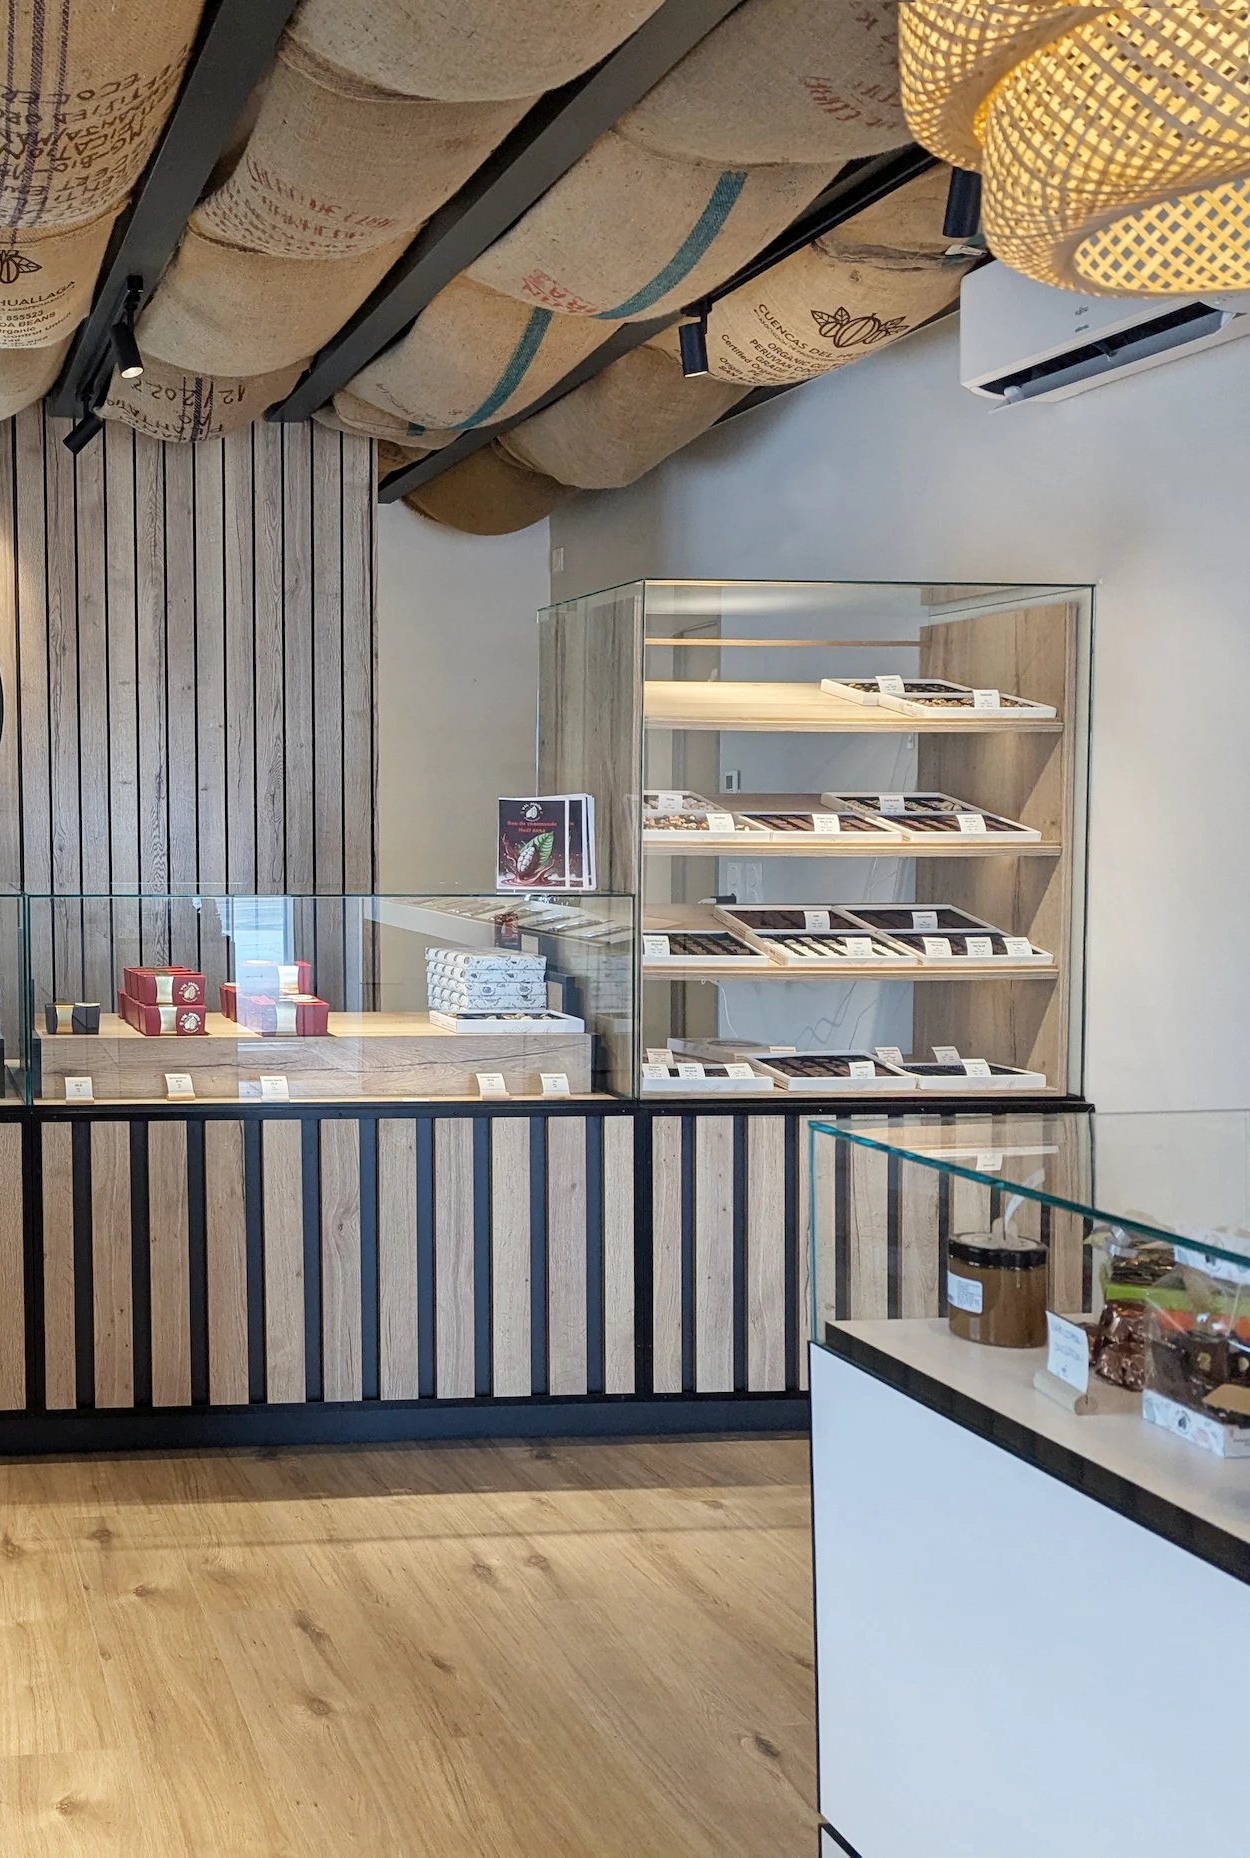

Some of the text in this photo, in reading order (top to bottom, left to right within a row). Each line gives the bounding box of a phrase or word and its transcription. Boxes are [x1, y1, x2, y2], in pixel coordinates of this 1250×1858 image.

[18, 312, 57, 327] BEANS
[758, 303, 808, 350] CUENCAS
[721, 334, 751, 364] Certified
[750, 338, 791, 369] PERUVIAN
[767, 342, 811, 368] ORGANIC
